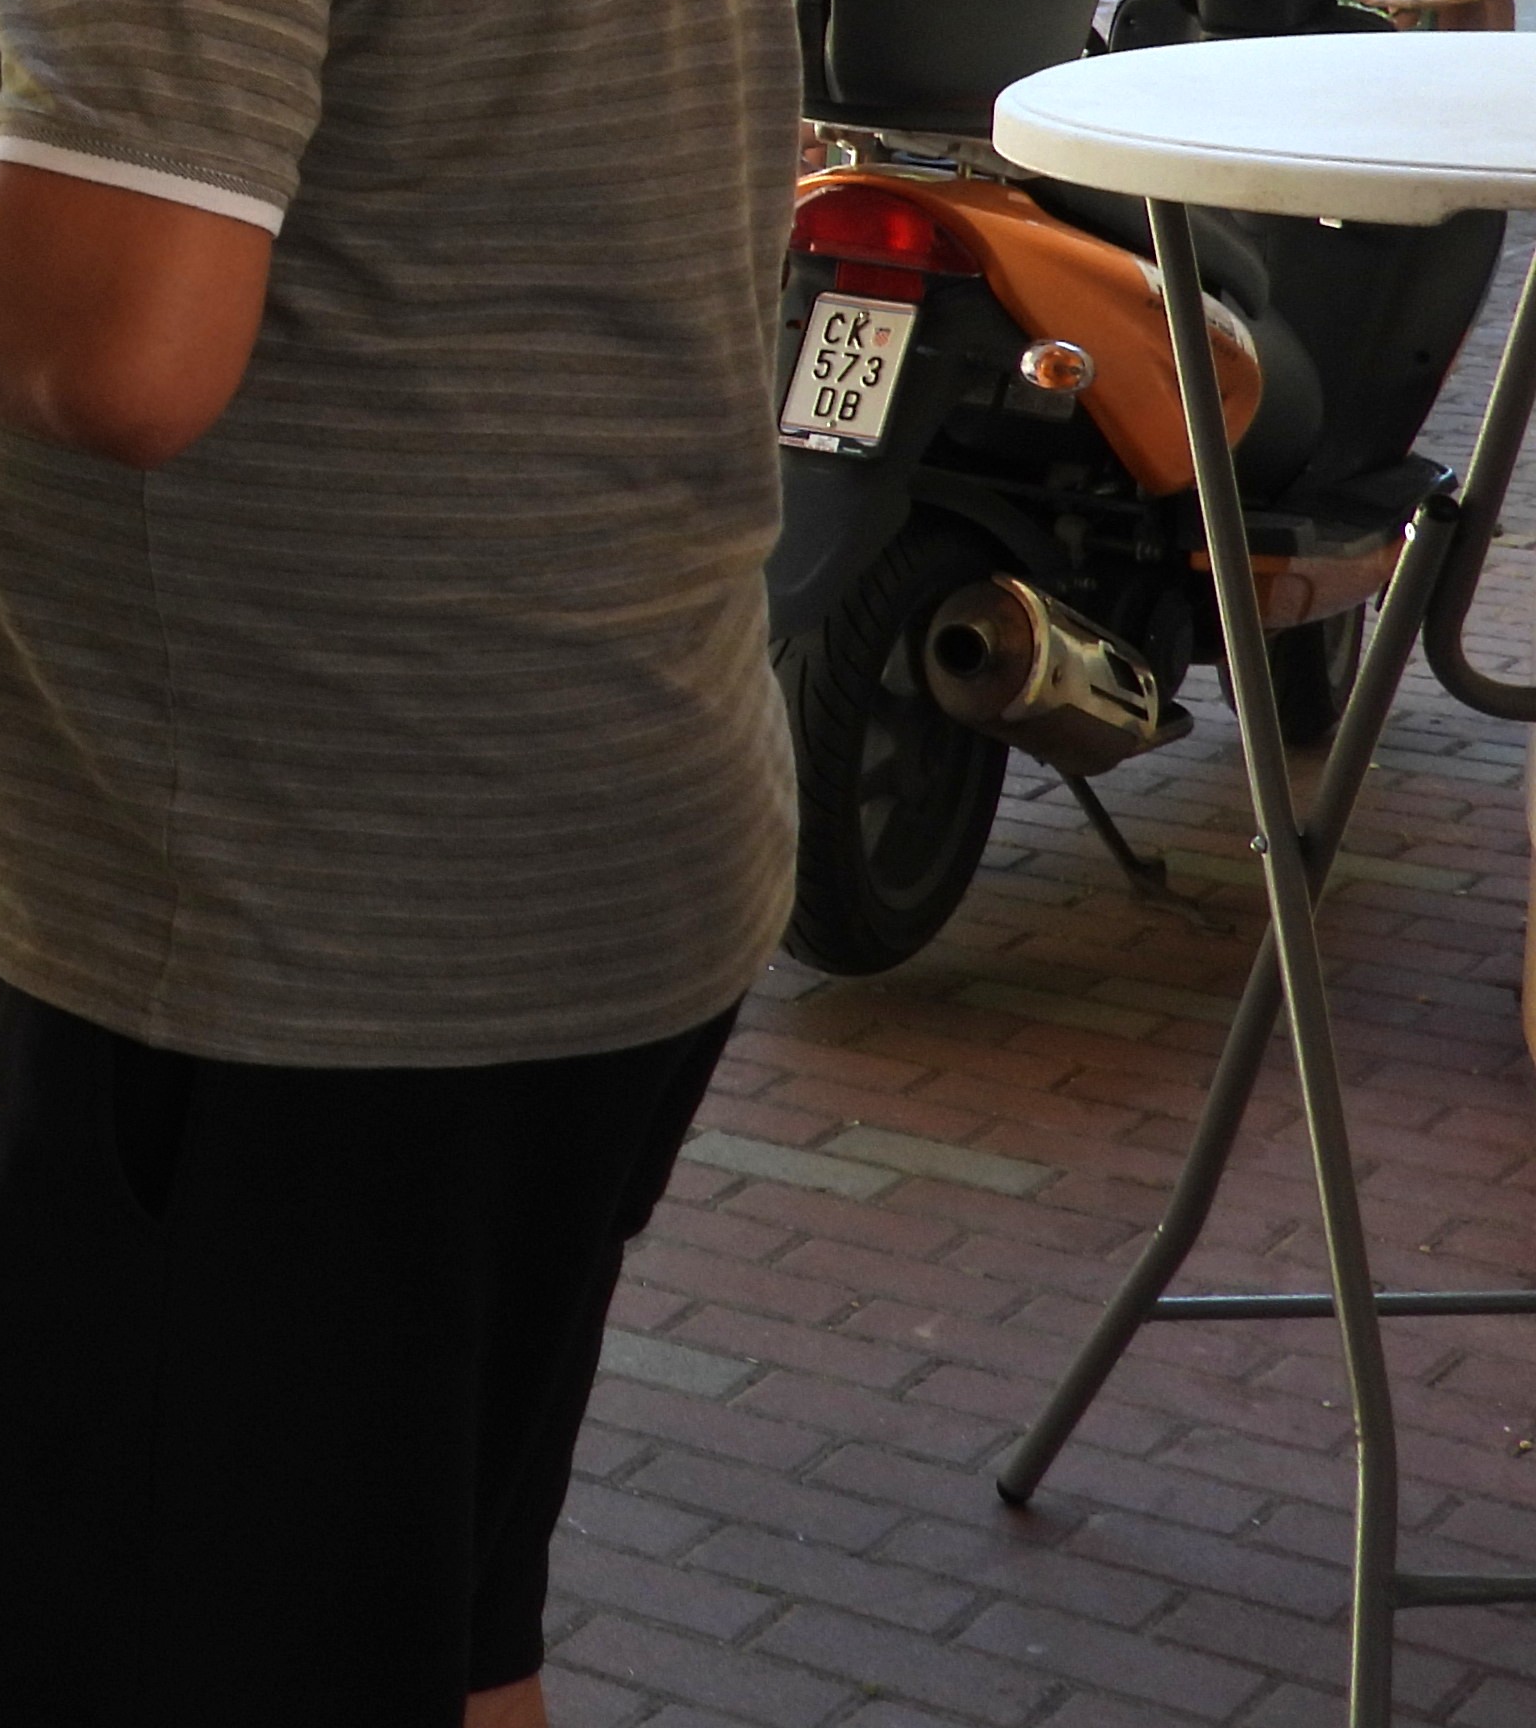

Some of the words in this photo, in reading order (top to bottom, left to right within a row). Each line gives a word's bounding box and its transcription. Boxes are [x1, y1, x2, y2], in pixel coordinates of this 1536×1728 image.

[823, 312, 870, 348] CK
[812, 349, 883, 387] 573
[812, 386, 861, 421] DB
